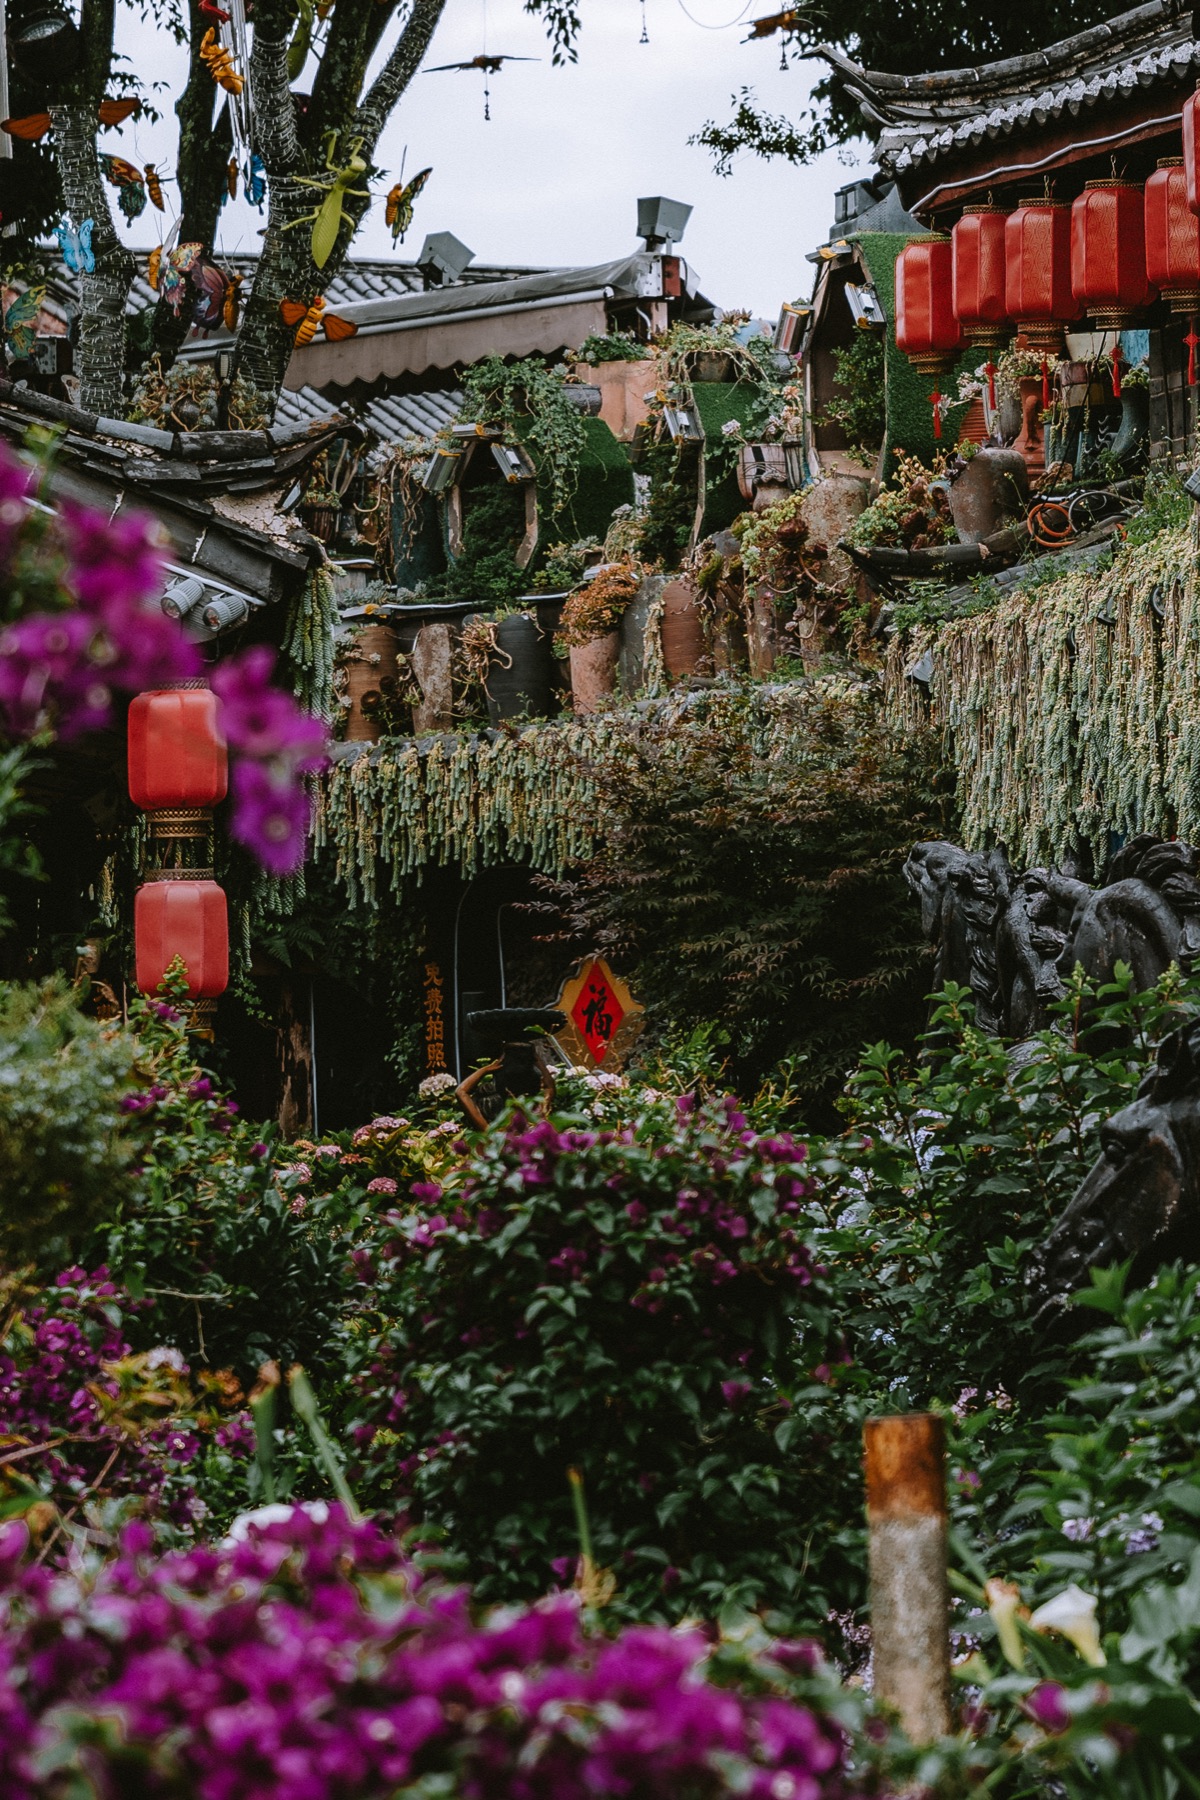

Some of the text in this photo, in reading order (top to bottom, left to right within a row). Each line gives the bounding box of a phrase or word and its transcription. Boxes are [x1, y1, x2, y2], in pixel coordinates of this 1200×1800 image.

[423, 961, 448, 1075] 免费拍照
[582, 984, 613, 1041] 福
